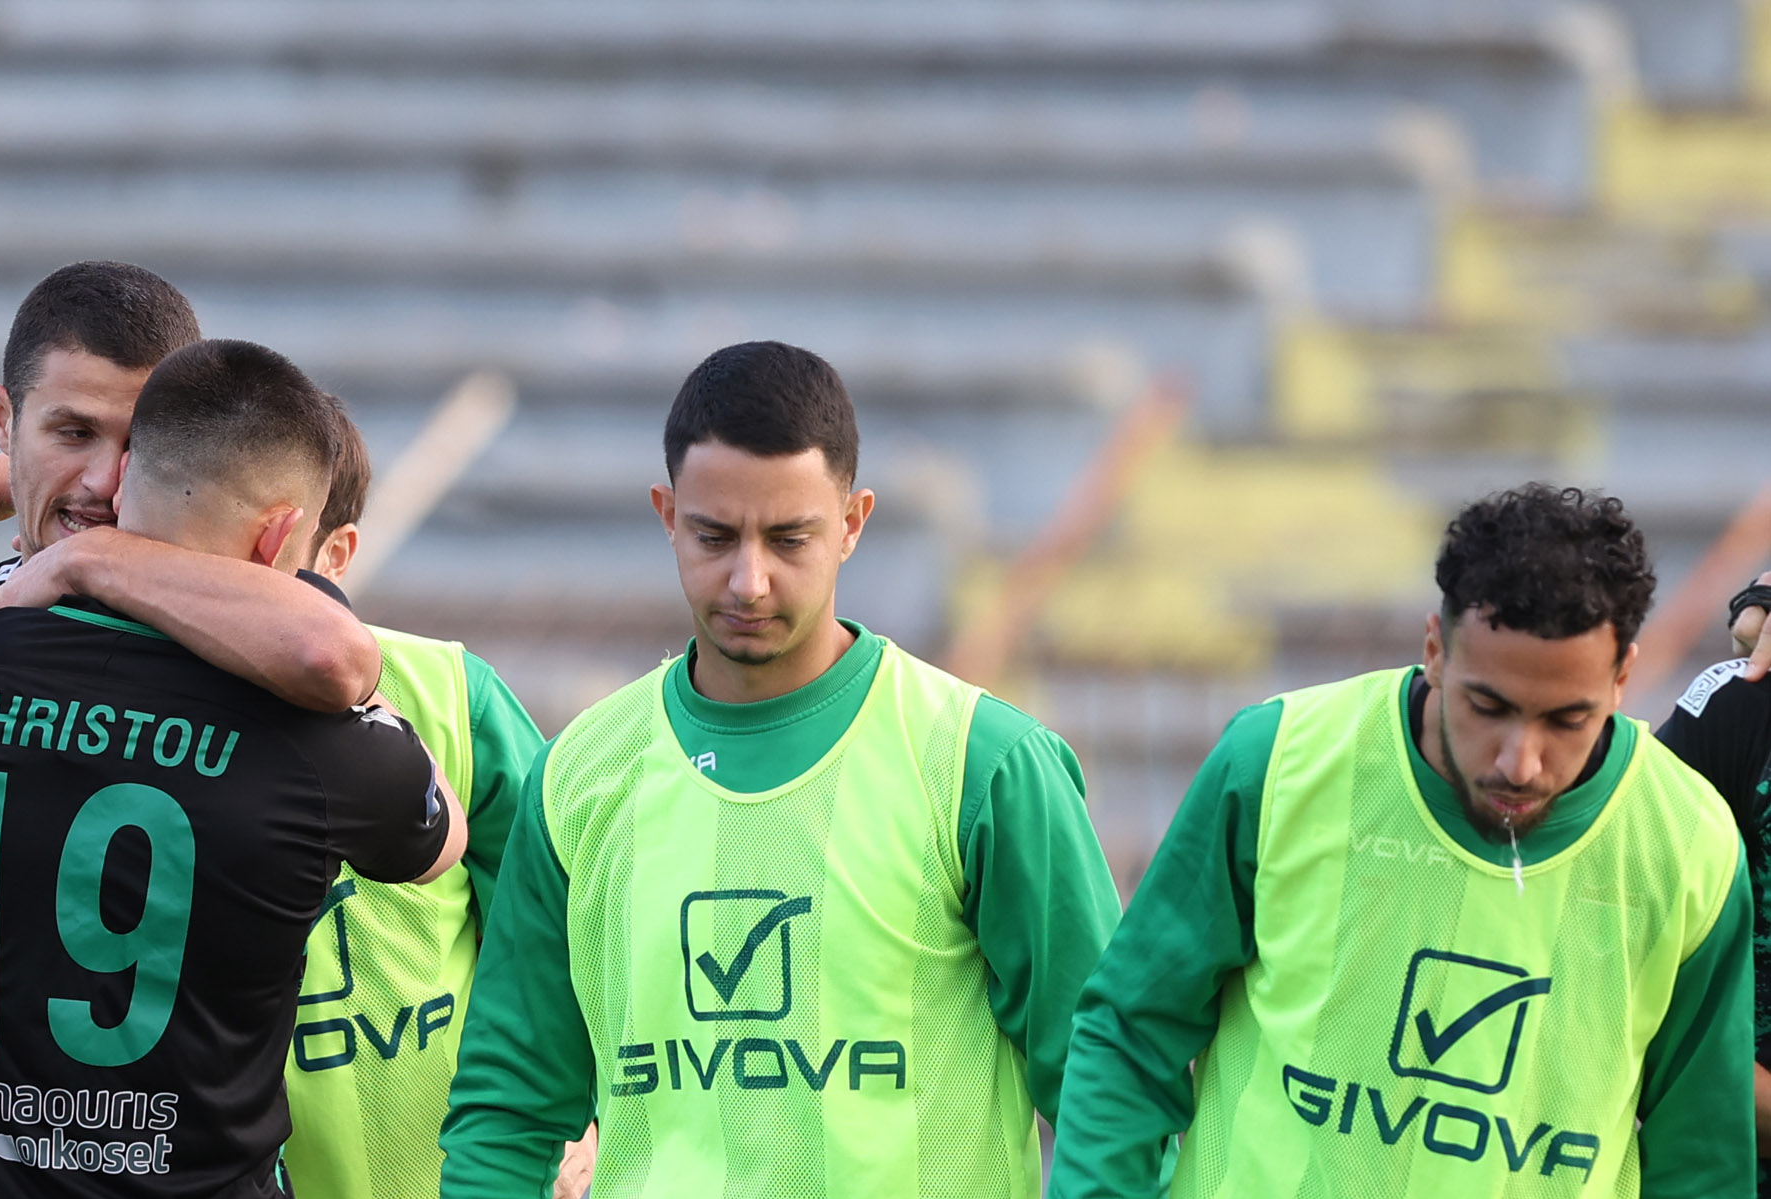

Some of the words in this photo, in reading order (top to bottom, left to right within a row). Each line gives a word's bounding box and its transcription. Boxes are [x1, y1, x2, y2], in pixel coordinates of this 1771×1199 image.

[293, 992, 455, 1073] OVA
[610, 1037, 907, 1098] GIVOVA
[1282, 1063, 1601, 1185] GIVOVA
